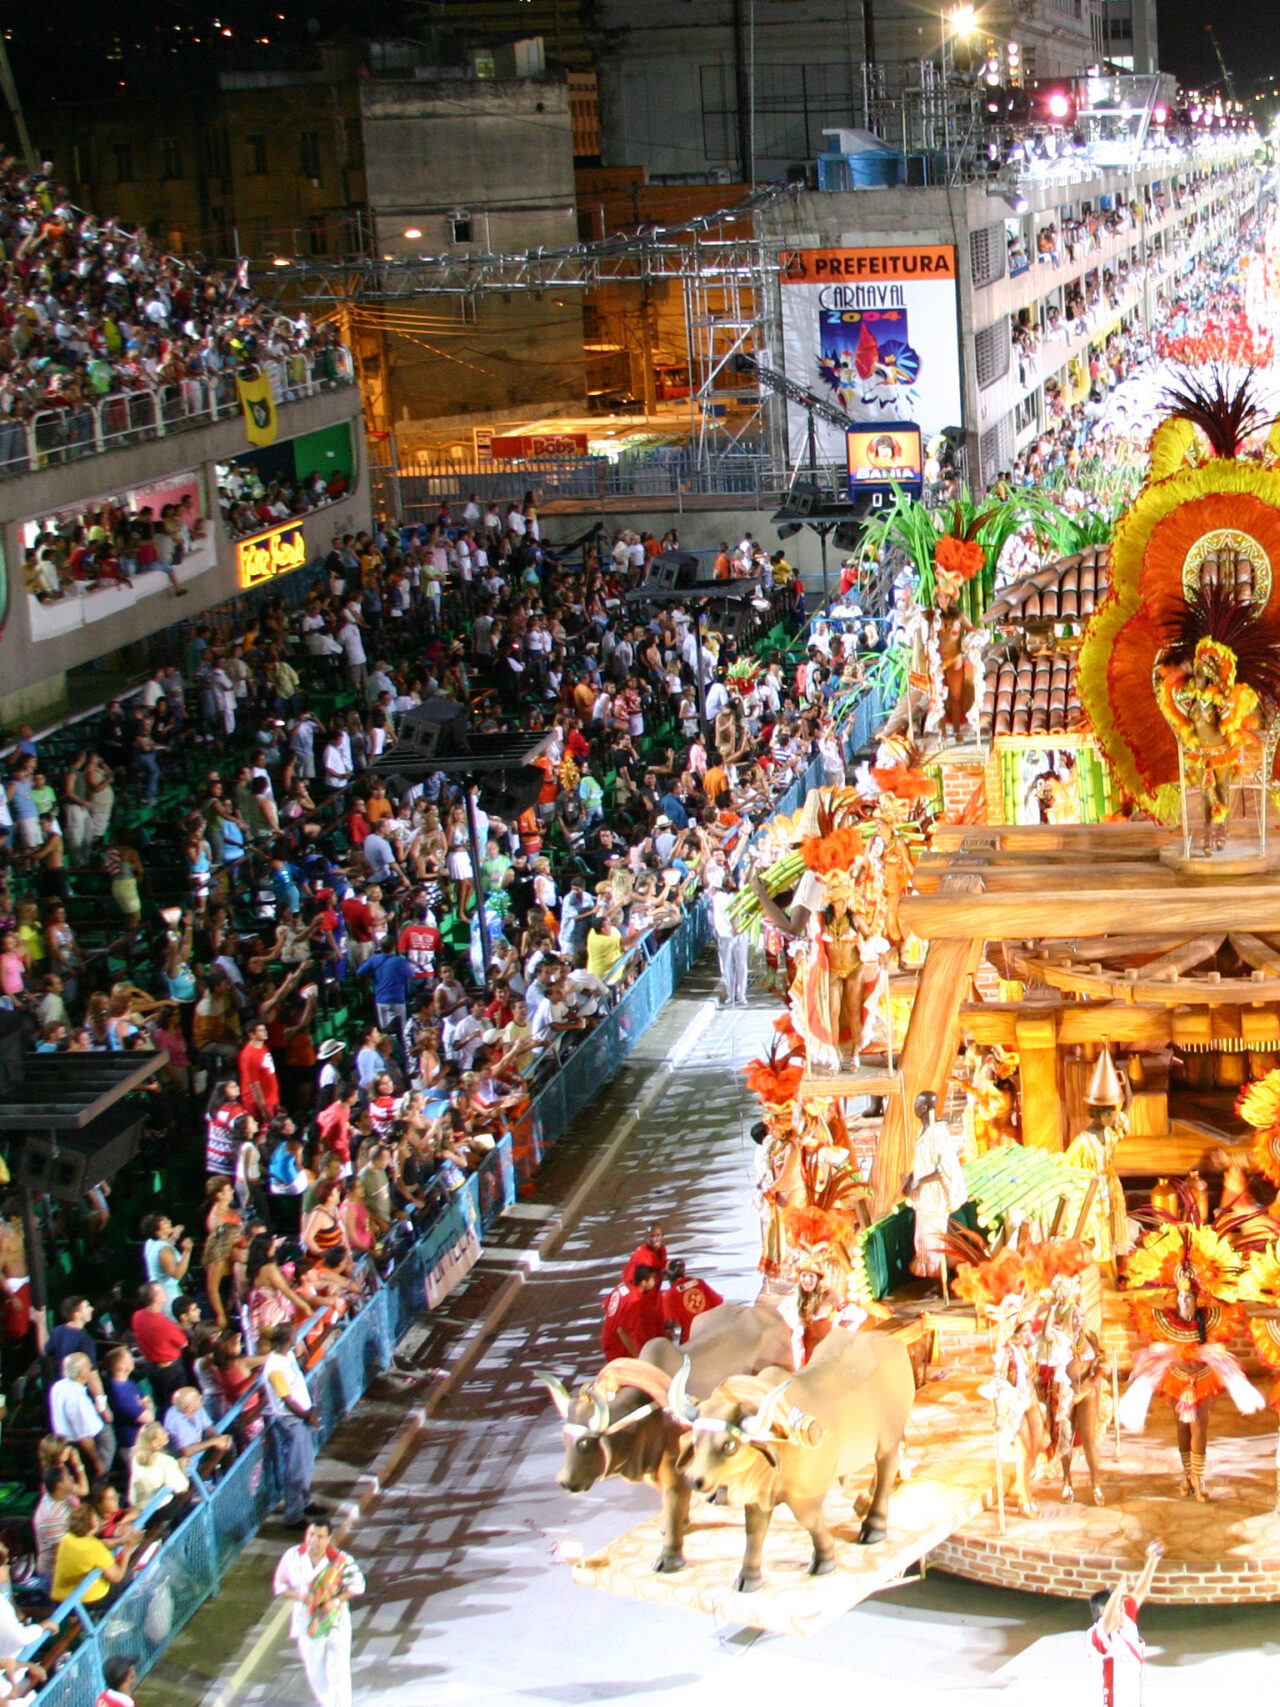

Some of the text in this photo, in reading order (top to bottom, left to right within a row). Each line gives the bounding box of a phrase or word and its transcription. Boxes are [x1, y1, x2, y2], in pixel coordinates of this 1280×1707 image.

[815, 255, 950, 275] PREFEITURA
[819, 284, 908, 311] CARNAVAL
[827, 311, 902, 324] 2004
[855, 466, 915, 480] BAHIA
